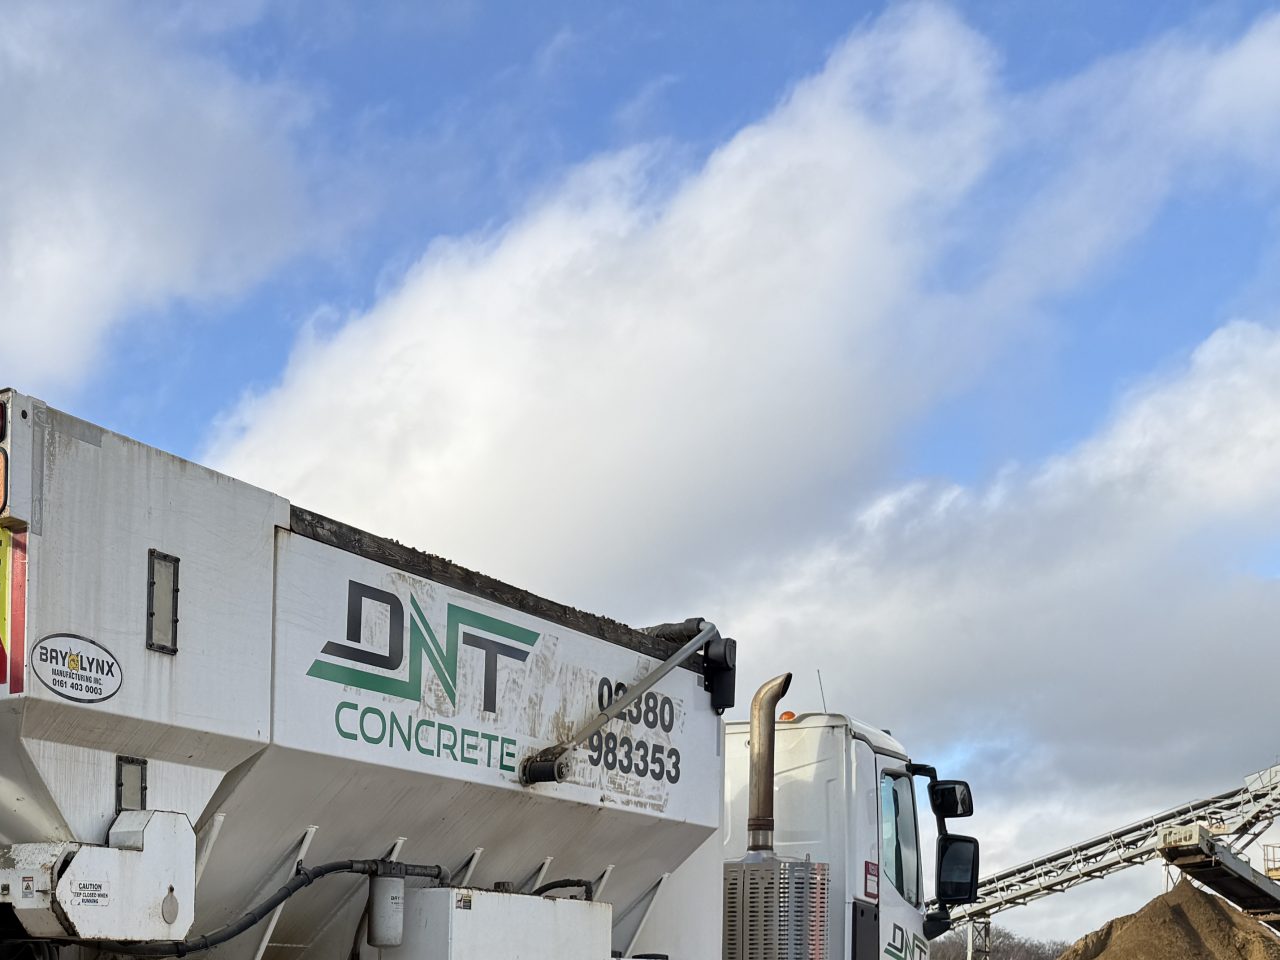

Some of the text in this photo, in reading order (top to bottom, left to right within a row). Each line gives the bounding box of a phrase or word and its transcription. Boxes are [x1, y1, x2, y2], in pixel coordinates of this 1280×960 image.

[40, 646, 114, 677] BAY LYNX
[306, 580, 540, 713] DNT
[52, 668, 92, 683] MANUFACTURING
[52, 678, 102, 695] 0161 403 0003
[335, 701, 516, 772] CONCRETE
[588, 730, 680, 784] 983353
[78, 882, 102, 890] CAUTION
